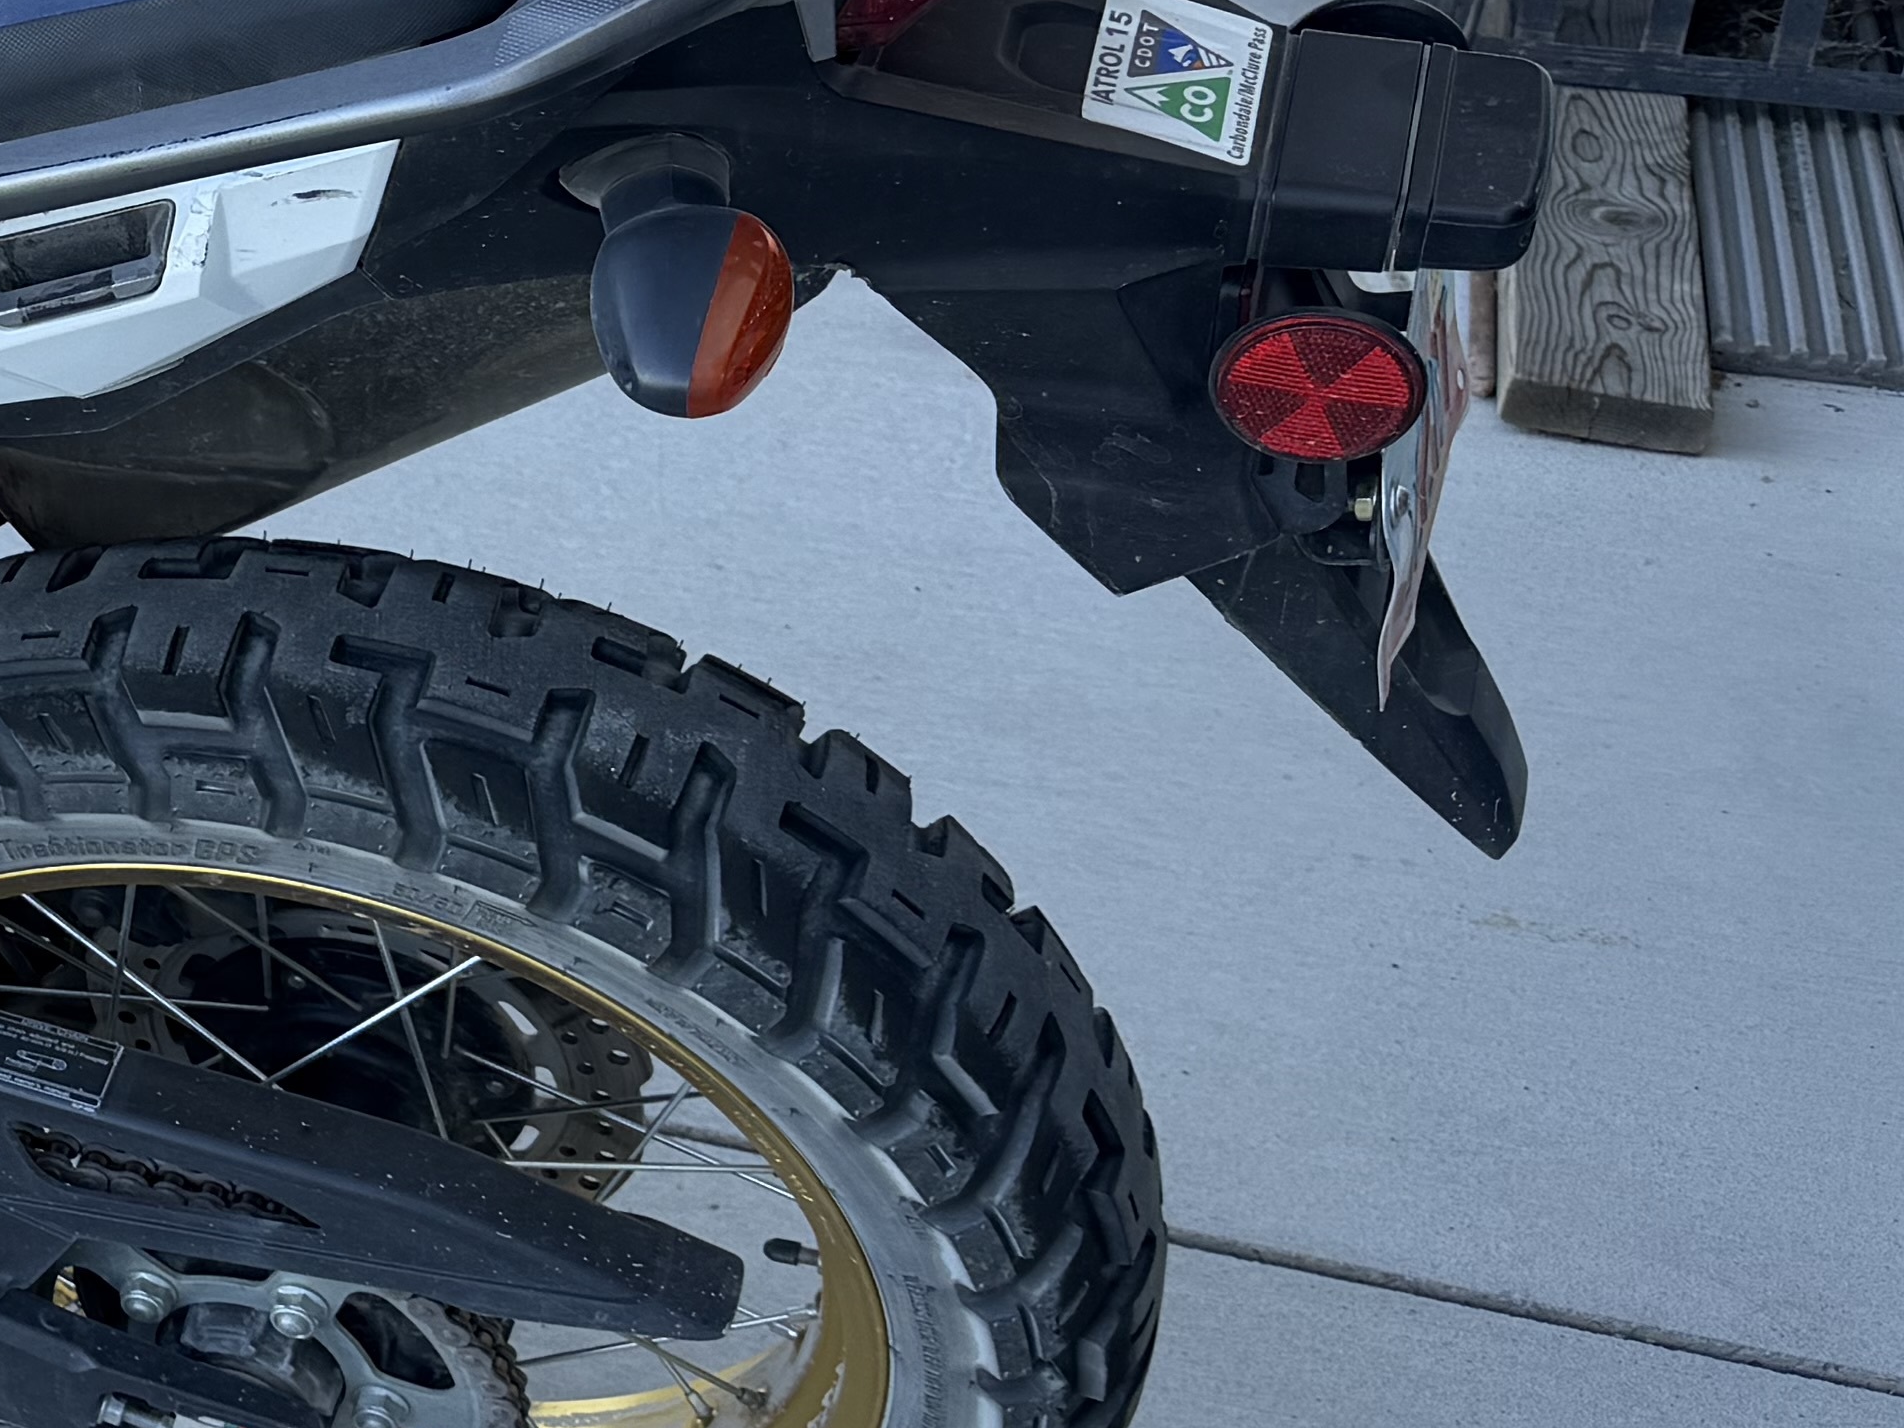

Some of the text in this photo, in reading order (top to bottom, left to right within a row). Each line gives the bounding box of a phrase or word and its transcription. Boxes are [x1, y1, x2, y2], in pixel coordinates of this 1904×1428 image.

[1105, 10, 1133, 36] 15
[1135, 23, 1159, 68] CDOT
[1180, 86, 1217, 122] CO
[1227, 27, 1267, 160] Carbondale/McClure Pass
